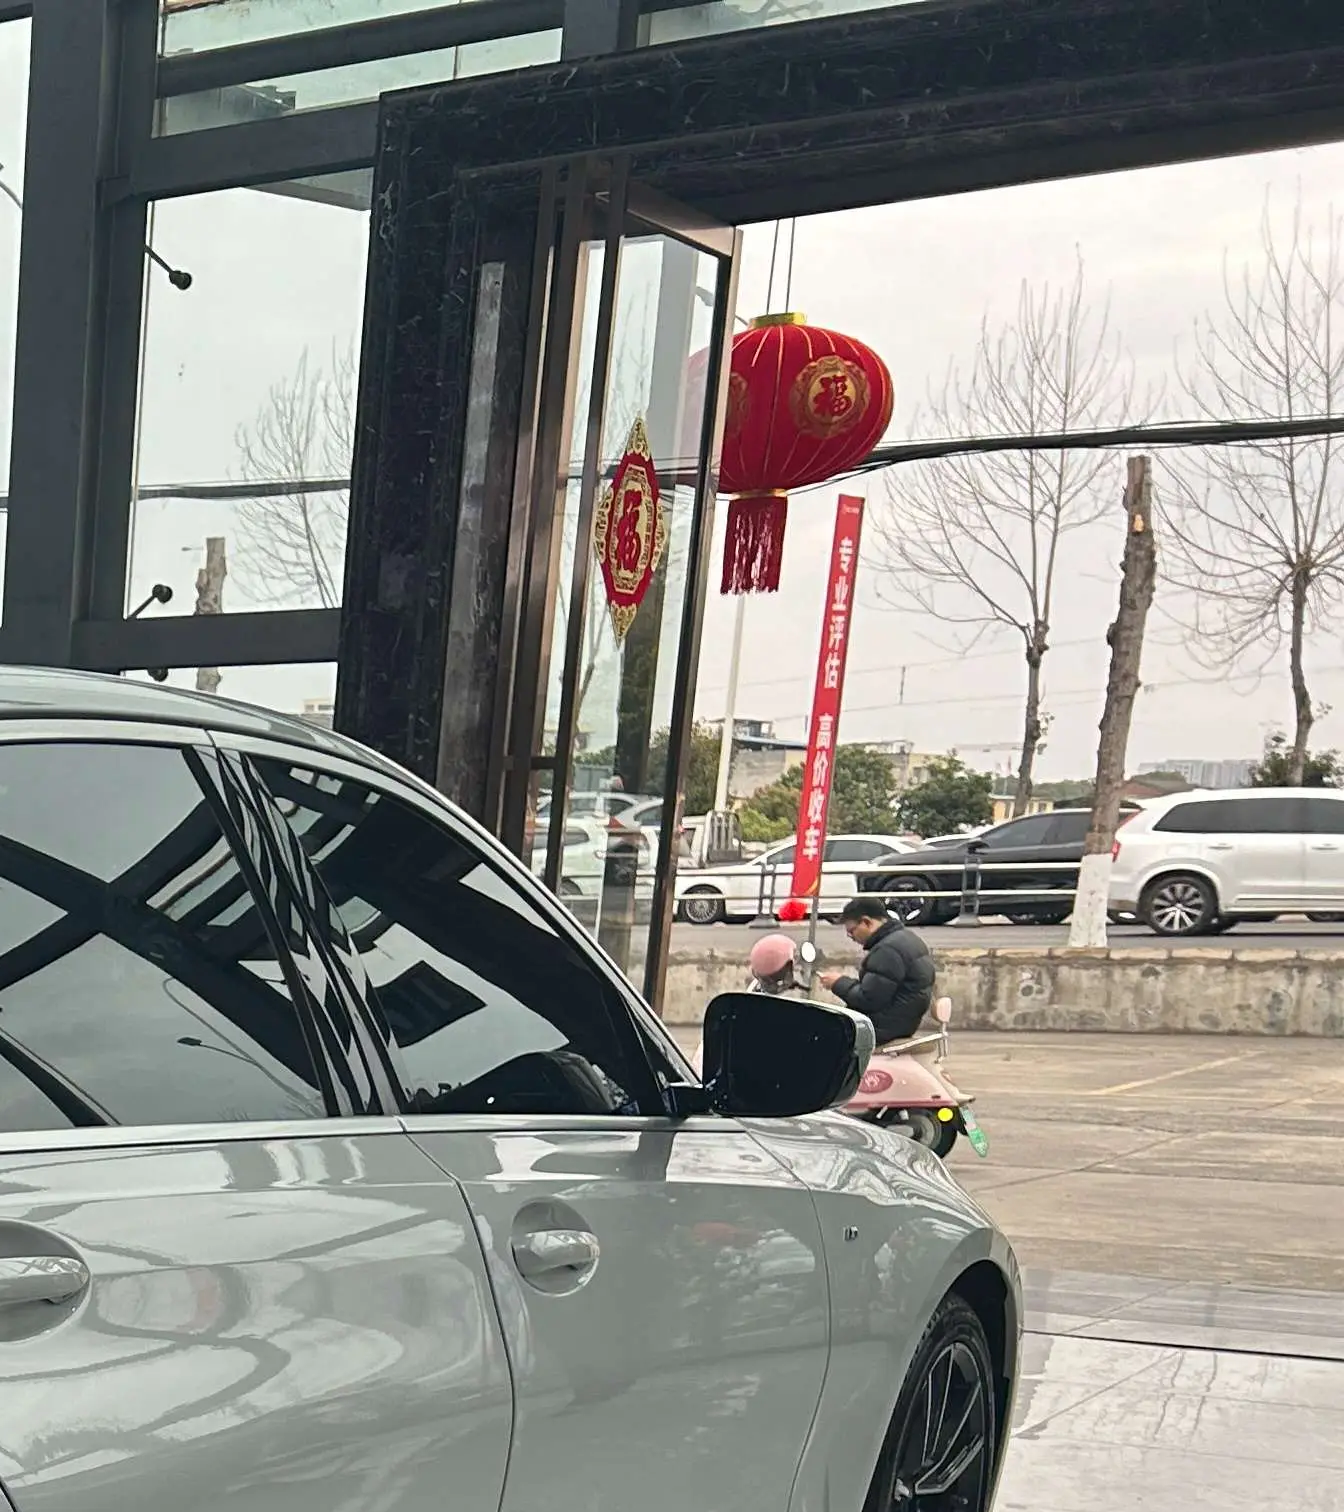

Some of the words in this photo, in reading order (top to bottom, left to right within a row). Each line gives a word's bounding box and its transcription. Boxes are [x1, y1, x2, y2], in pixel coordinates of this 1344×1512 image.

[813, 374, 853, 417] 福
[615, 488, 643, 572] 福
[823, 535, 854, 689] 专业评估
[802, 712, 834, 862] 高价收车
